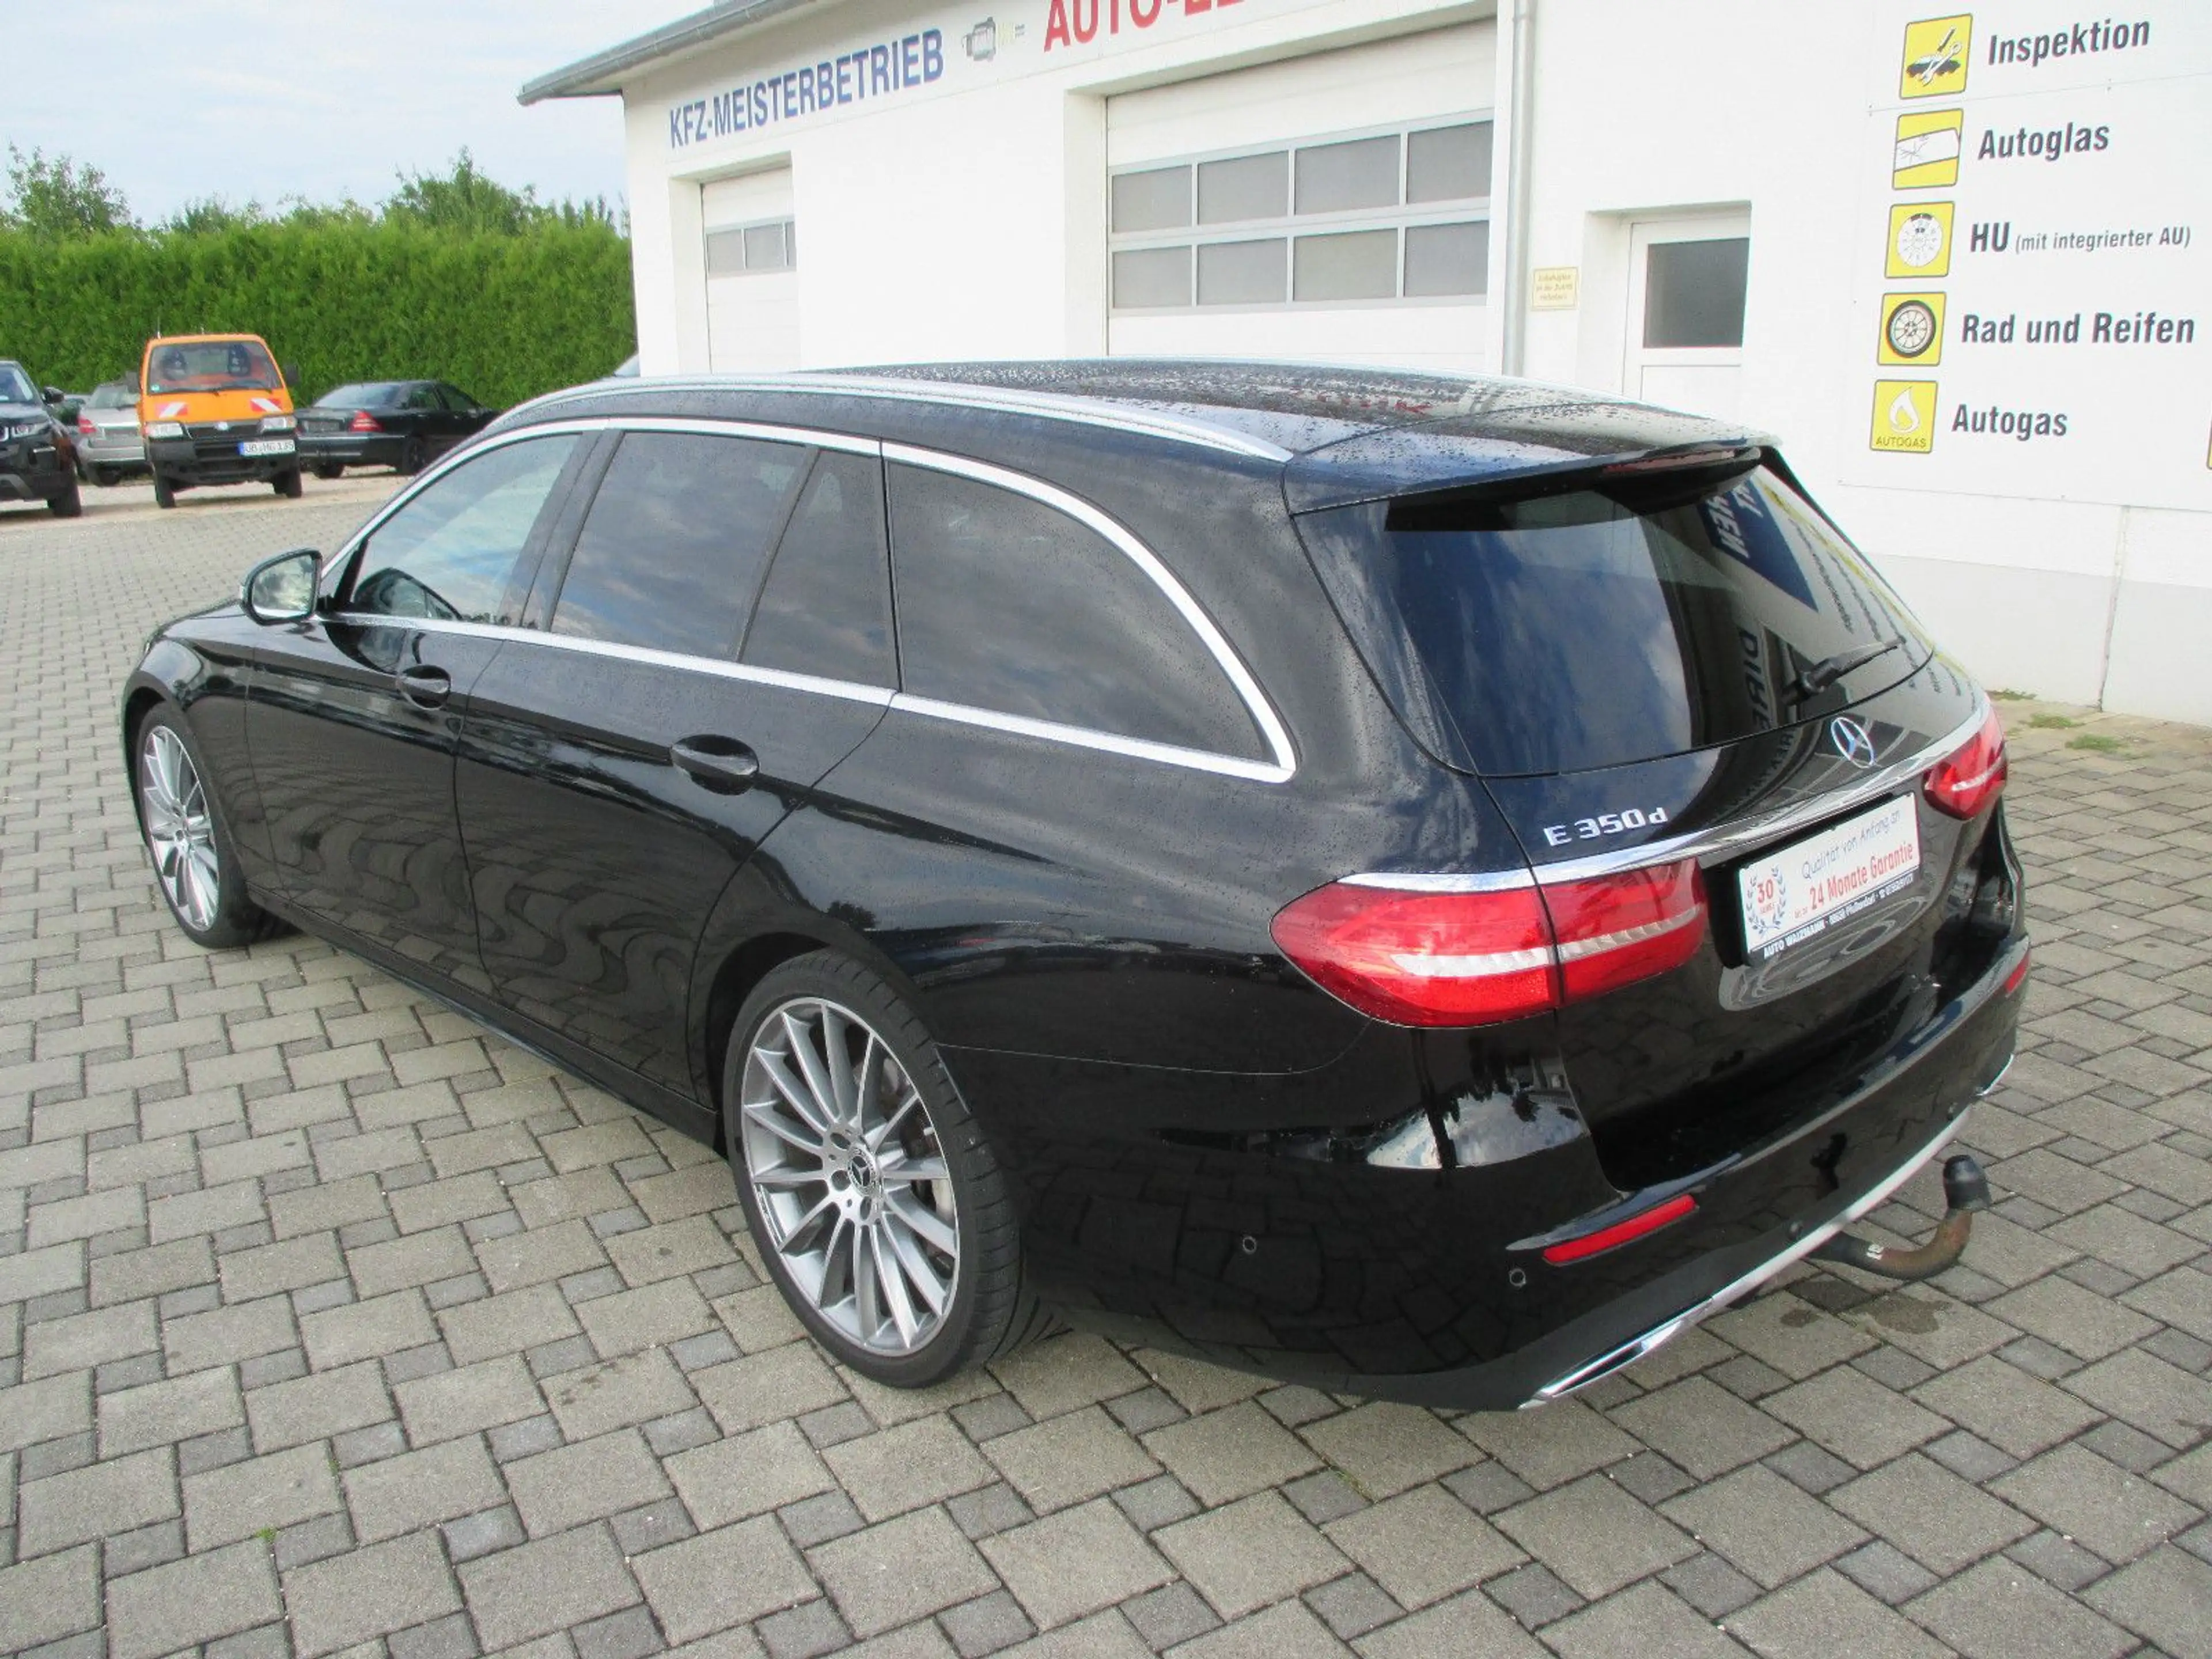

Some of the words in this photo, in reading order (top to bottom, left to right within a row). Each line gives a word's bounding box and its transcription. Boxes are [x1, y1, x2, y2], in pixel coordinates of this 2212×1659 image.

[1988, 19, 2150, 67] Inspektion
[670, 29, 944, 148] KFZ-MEISTERBETRIEB
[1978, 123, 2109, 162] Autoglas
[1970, 222, 2010, 252] HU
[2015, 232, 2047, 254] (mit
[2053, 230, 2153, 252] integrierter
[2158, 226, 2191, 248] AU)
[1962, 313, 2014, 343] Rad
[2027, 313, 2080, 343] und
[2092, 312, 2195, 343] Reifen
[1952, 404, 2068, 441] Autogas
[1876, 436, 1927, 449] AUTOGAS
[1544, 825, 1573, 846] E
[1574, 809, 1646, 839] 350
[1842, 836, 1858, 857] von
[1891, 810, 1901, 826] an
[1757, 878, 1774, 904] 30
[1809, 883, 1824, 911] 24
[1827, 865, 1868, 902] Monate
[1870, 842, 1913, 880] Garantie
